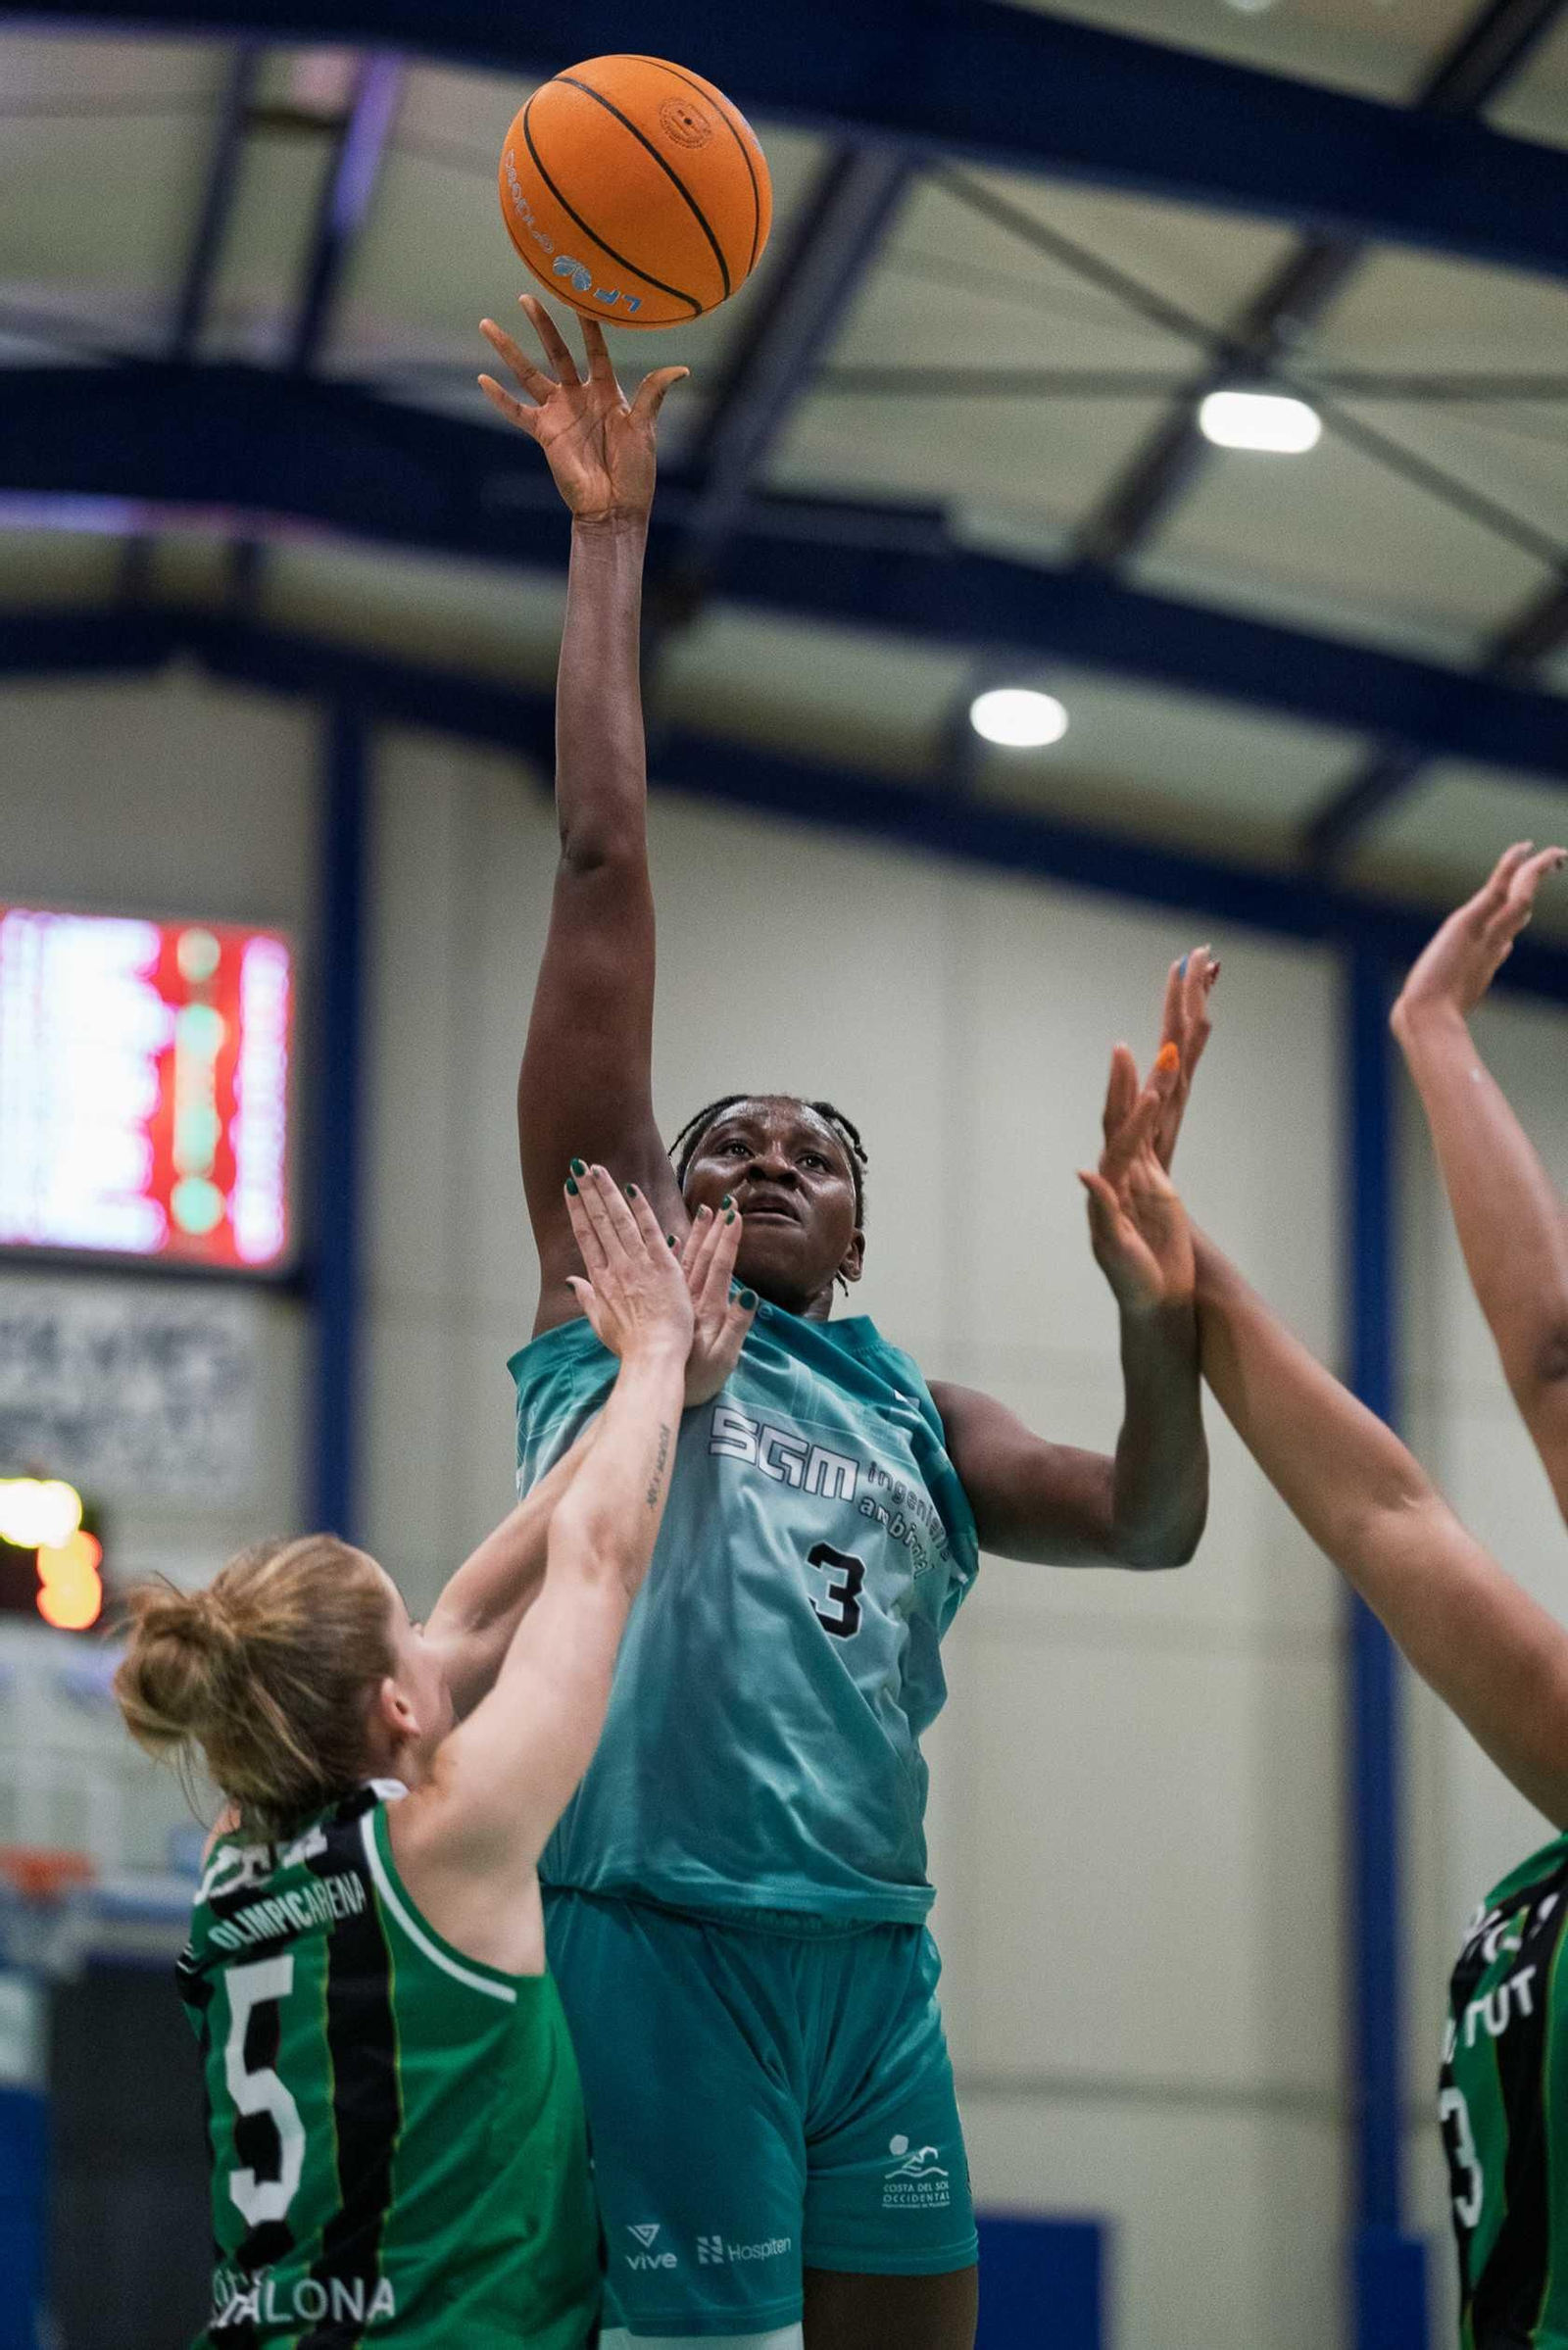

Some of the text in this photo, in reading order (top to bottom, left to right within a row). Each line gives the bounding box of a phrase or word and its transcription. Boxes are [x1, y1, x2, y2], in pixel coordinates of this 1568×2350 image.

[708, 1405, 859, 1502] SGM
[806, 1541, 867, 1640] 3
[224, 1954, 306, 2228] 5
[883, 2179, 950, 2193] COSTA DEL SOL
[883, 2190, 951, 2204] OCCIDENTAL
[624, 2251, 678, 2272] vive
[727, 2235, 793, 2264] Hospiten
